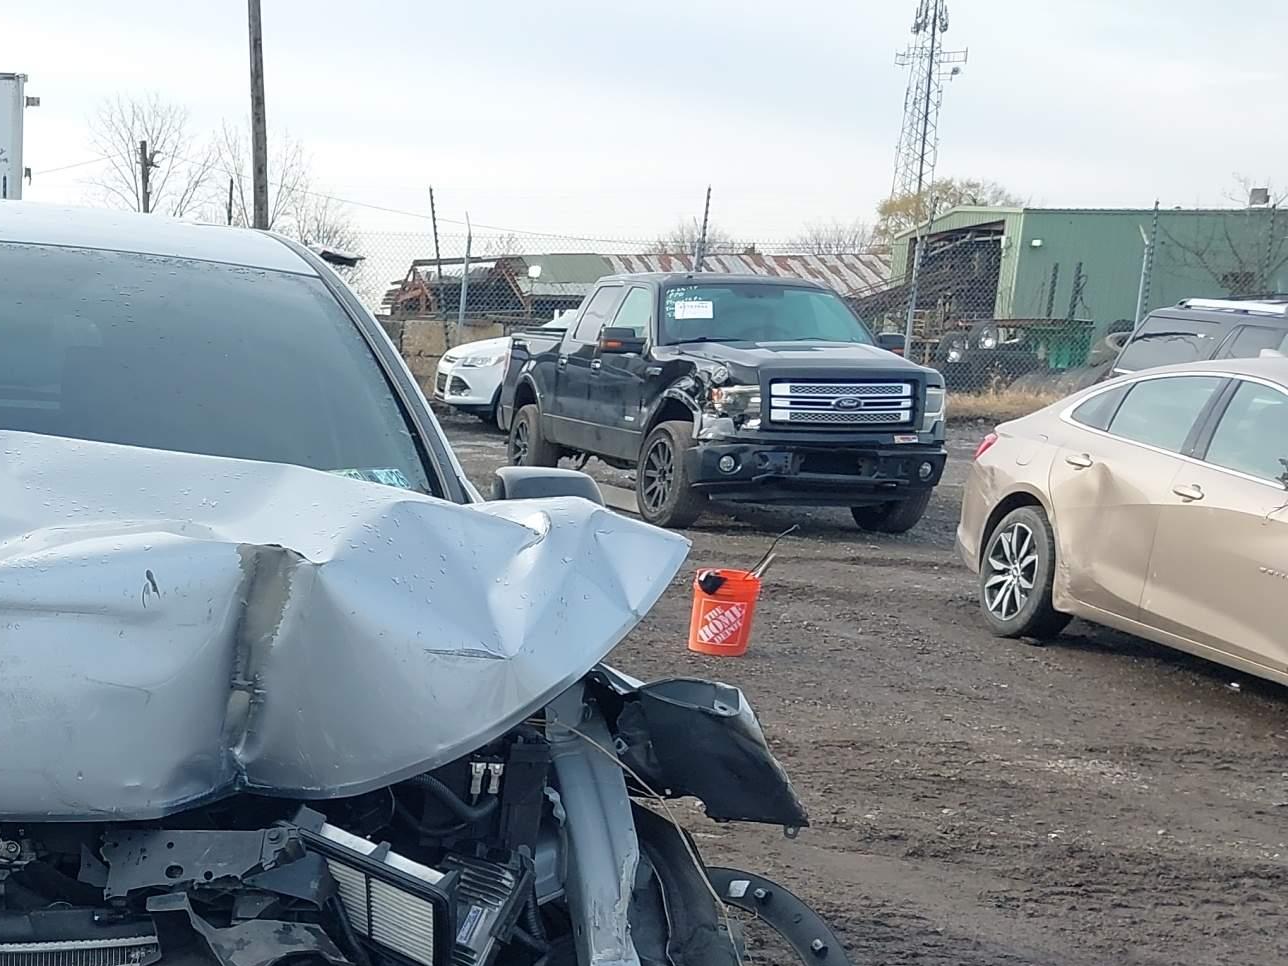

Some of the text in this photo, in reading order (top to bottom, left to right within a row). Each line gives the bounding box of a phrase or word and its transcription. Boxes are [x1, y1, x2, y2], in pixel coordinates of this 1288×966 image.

[697, 604, 745, 642] HOME
[704, 605, 724, 622] THE
[713, 619, 744, 644] DEPOT
